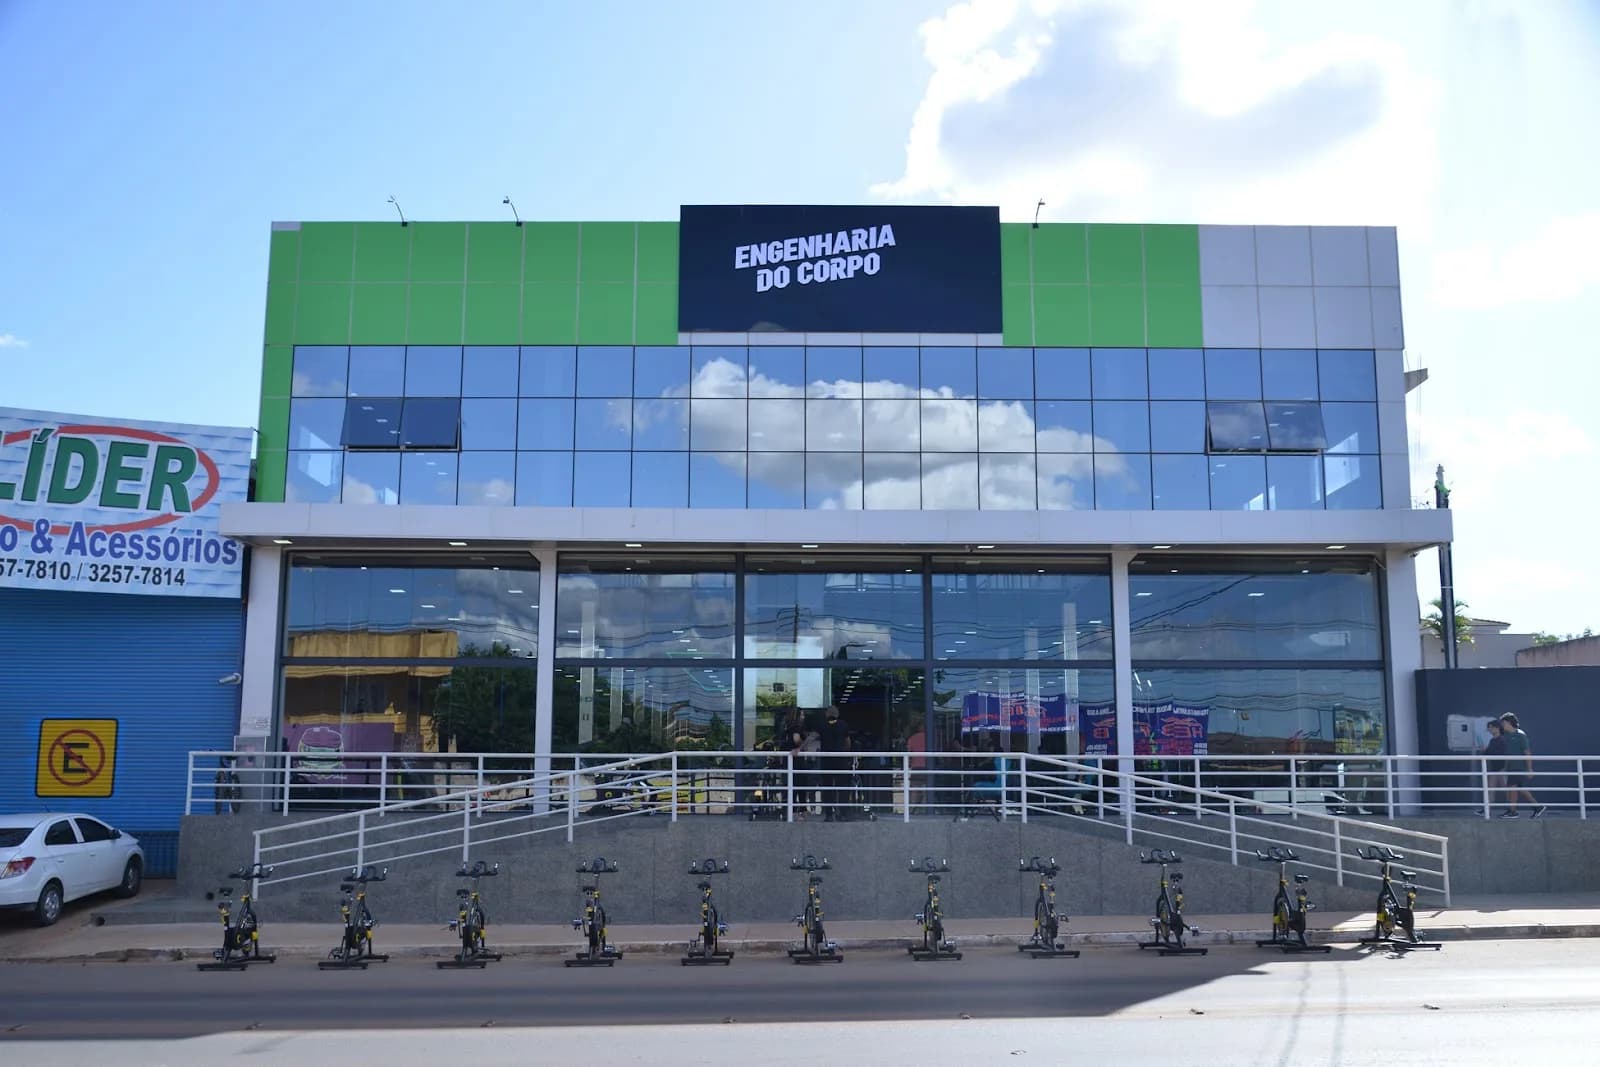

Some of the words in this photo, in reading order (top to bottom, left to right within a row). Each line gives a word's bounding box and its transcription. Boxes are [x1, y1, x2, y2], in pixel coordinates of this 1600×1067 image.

[735, 224, 896, 269] ENGENHARIA
[757, 265, 790, 292] DO
[797, 252, 880, 285] CORPO
[31, 519, 53, 554] &
[65, 521, 238, 565] Acessórios
[88, 563, 185, 587] 3257-7814
